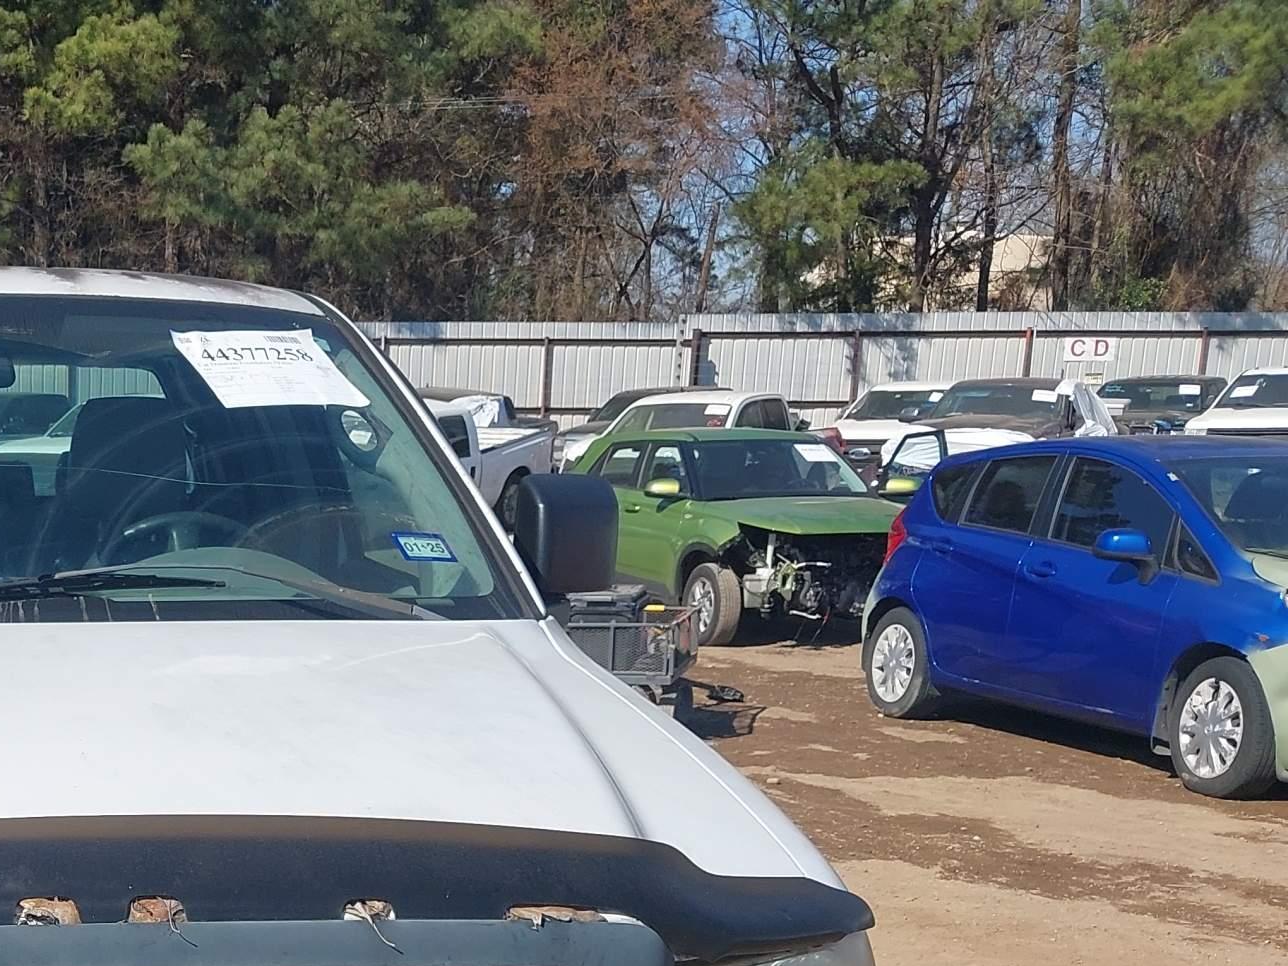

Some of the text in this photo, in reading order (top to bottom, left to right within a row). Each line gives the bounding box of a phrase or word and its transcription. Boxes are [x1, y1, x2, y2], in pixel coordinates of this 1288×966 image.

[201, 347, 314, 362] 44377258
[1070, 339, 1110, 357] C D
[403, 541, 445, 554] 01 25
